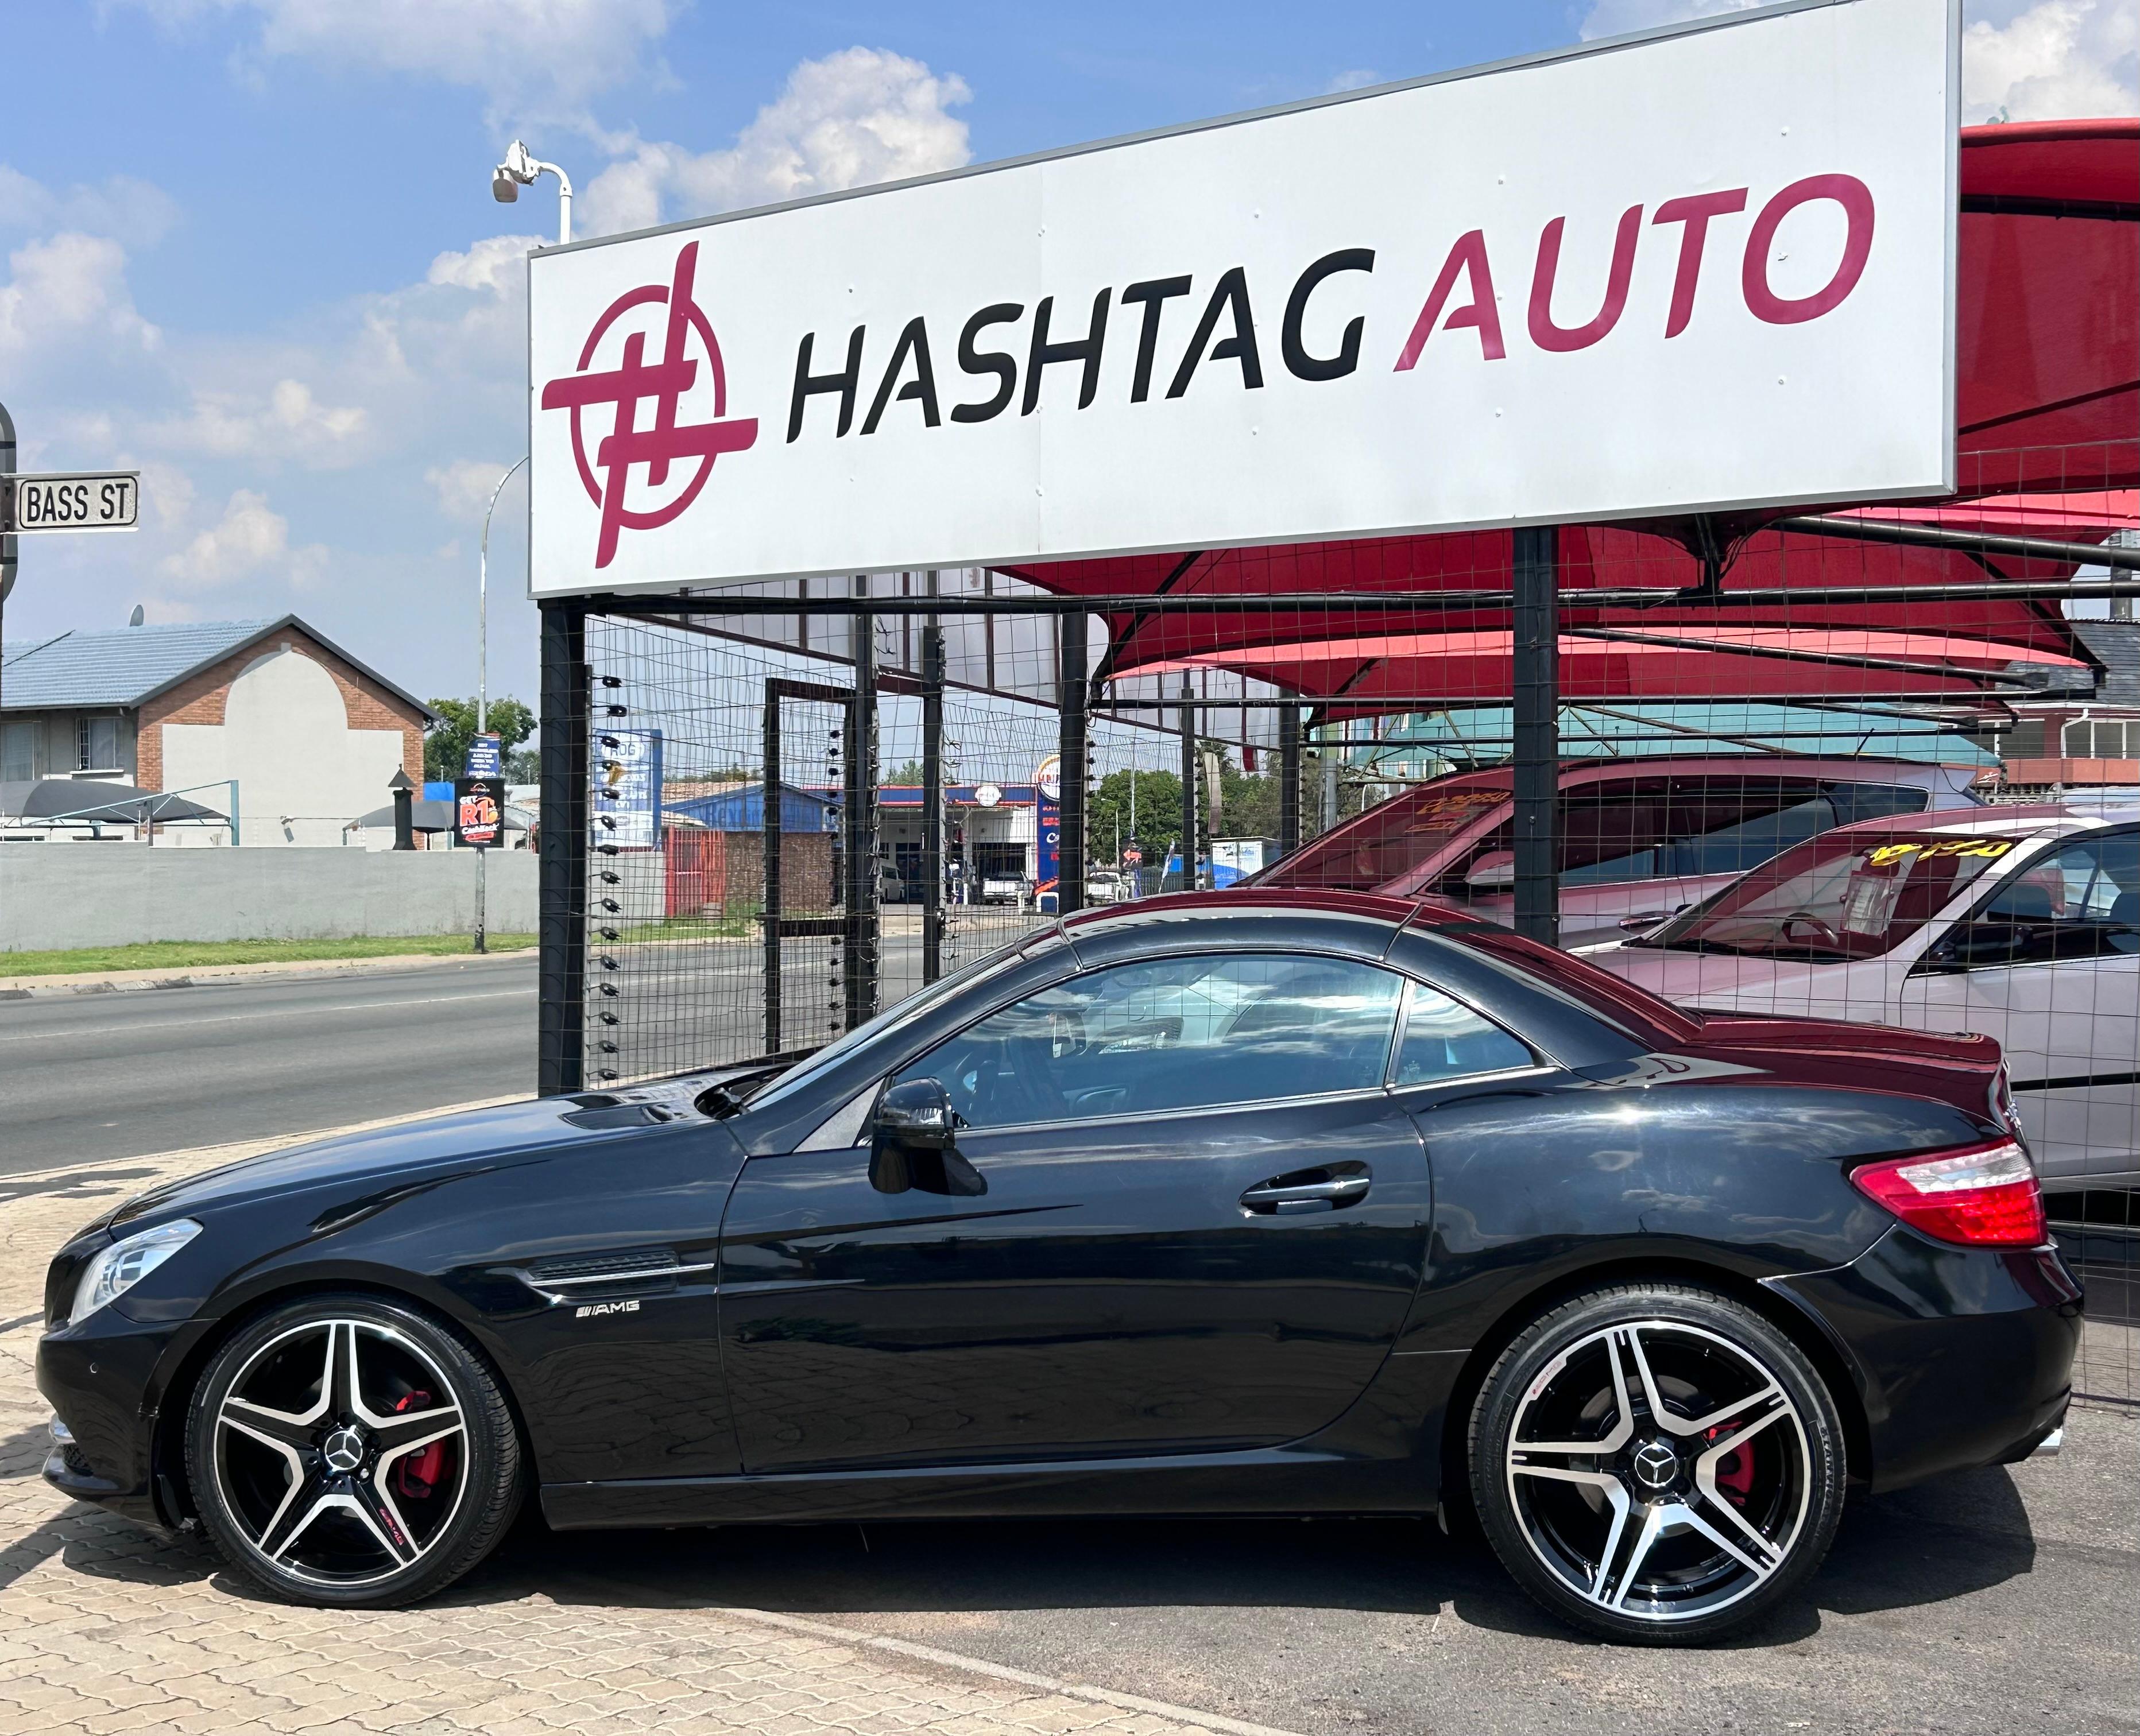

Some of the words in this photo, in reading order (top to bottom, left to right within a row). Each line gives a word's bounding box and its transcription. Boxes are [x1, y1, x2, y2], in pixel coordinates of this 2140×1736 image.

[786, 248, 1375, 443] HASHTAG
[1393, 173, 1875, 372] AUTO
[28, 485, 88, 522] BASS
[100, 483, 129, 519] ST
[594, 1300, 640, 1315] AMG
